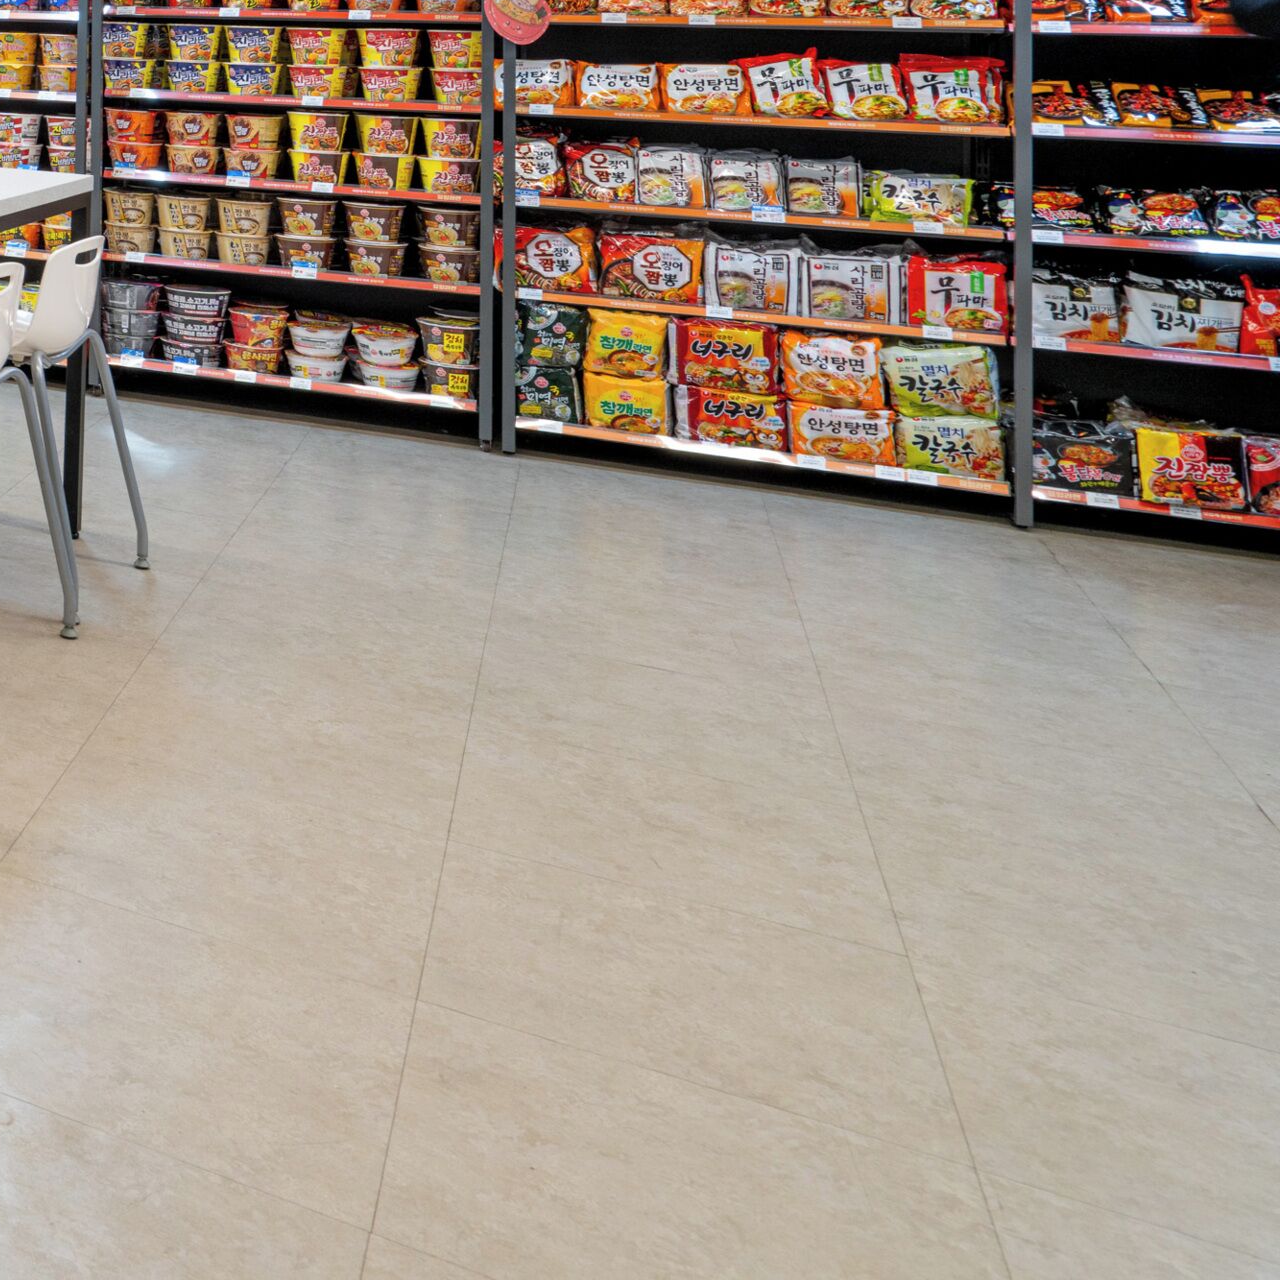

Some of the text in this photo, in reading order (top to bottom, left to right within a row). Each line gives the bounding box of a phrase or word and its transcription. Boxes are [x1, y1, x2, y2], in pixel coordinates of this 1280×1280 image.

[587, 73, 650, 87] 안성탕면
[674, 78, 739, 91] 안성탕면
[594, 170, 626, 183] 짬뽕
[539, 258, 571, 271] 짬뽕
[640, 251, 683, 270] 오징어
[645, 270, 678, 286] 짬뽕
[1045, 300, 1089, 320] 김치
[1151, 308, 1195, 333] 김치
[599, 336, 652, 354] 참깨라면
[691, 340, 754, 360] 너구리
[797, 352, 865, 372] 안성탕면
[920, 364, 949, 377] 멸치
[899, 374, 964, 403] 칼국수
[600, 401, 653, 418] 참깨라면
[704, 400, 766, 420] 너구리
[807, 417, 878, 436] 안성탕면
[937, 425, 965, 439] 멸치
[912, 434, 977, 464] 칼국수
[1154, 456, 1234, 482] 진짬뽕
